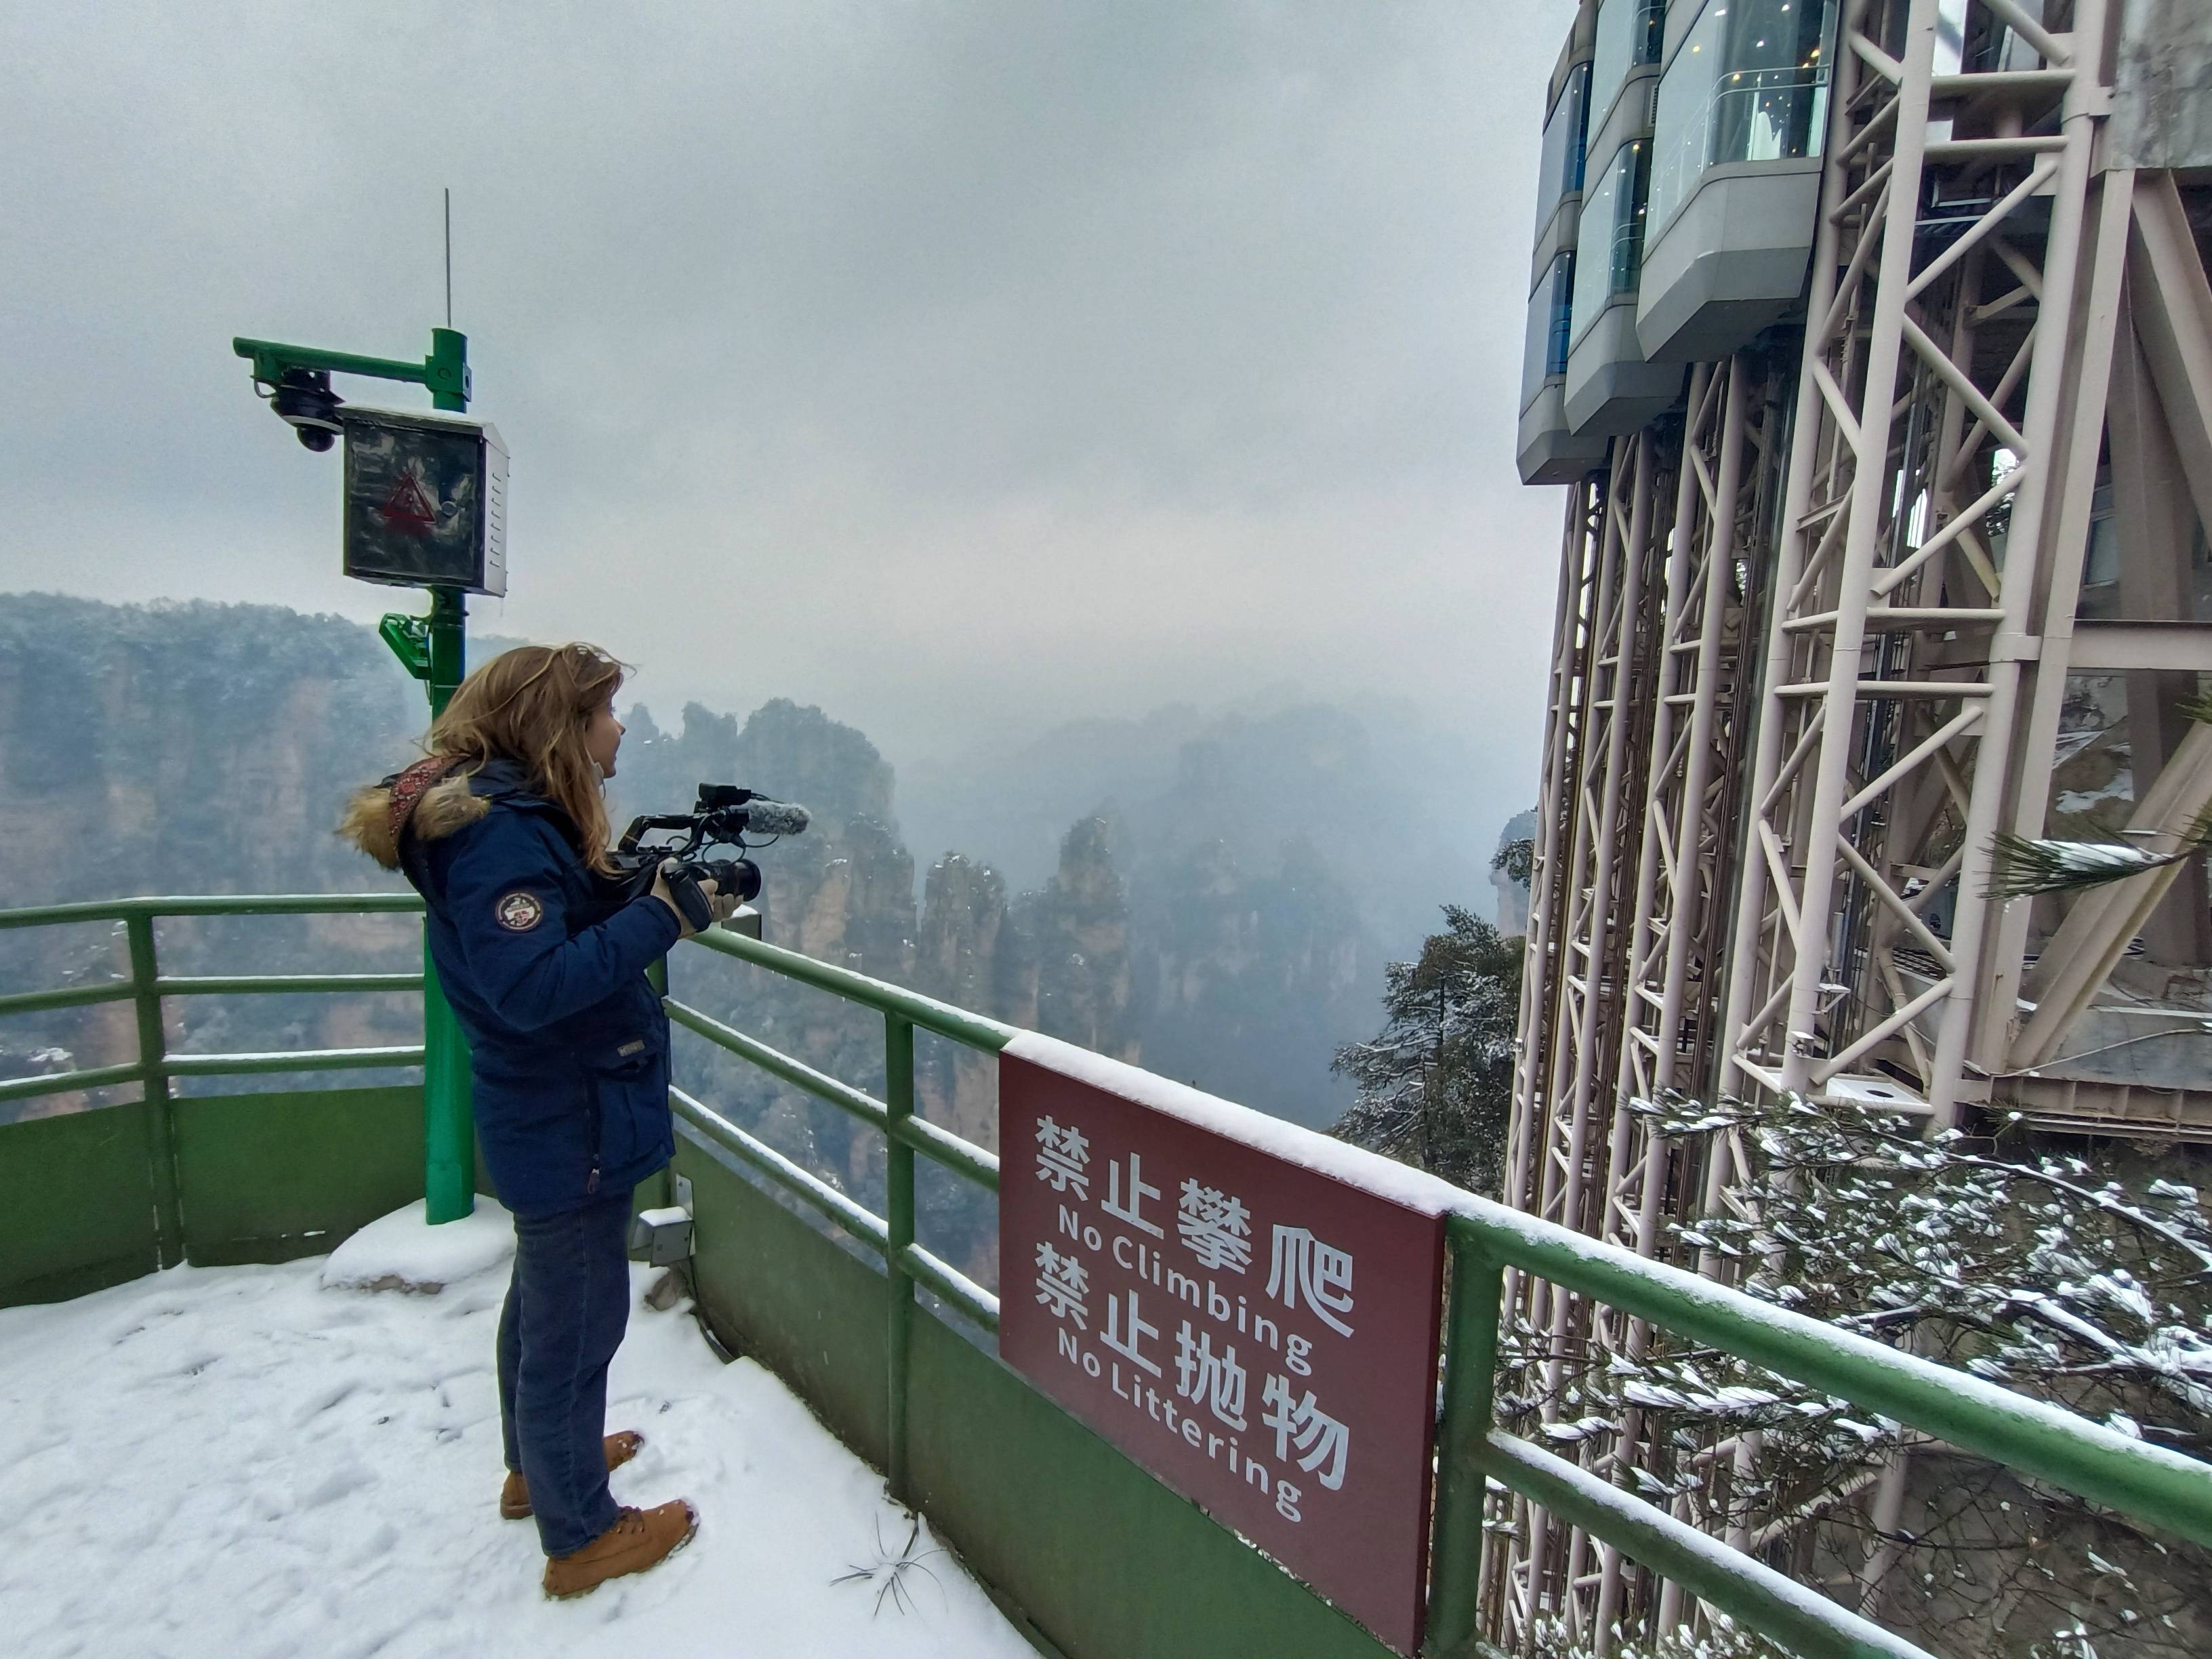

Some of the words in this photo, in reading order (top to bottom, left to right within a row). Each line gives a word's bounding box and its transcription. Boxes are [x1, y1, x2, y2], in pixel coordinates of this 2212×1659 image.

[1034, 1115, 1355, 1338] 禁止攀爬
[1059, 1204, 1102, 1252] No
[1113, 1235, 1313, 1376] Climbing
[1034, 1241, 1349, 1491] 禁止抛物
[1059, 1327, 1101, 1377] No
[1112, 1362, 1302, 1523] Littering
